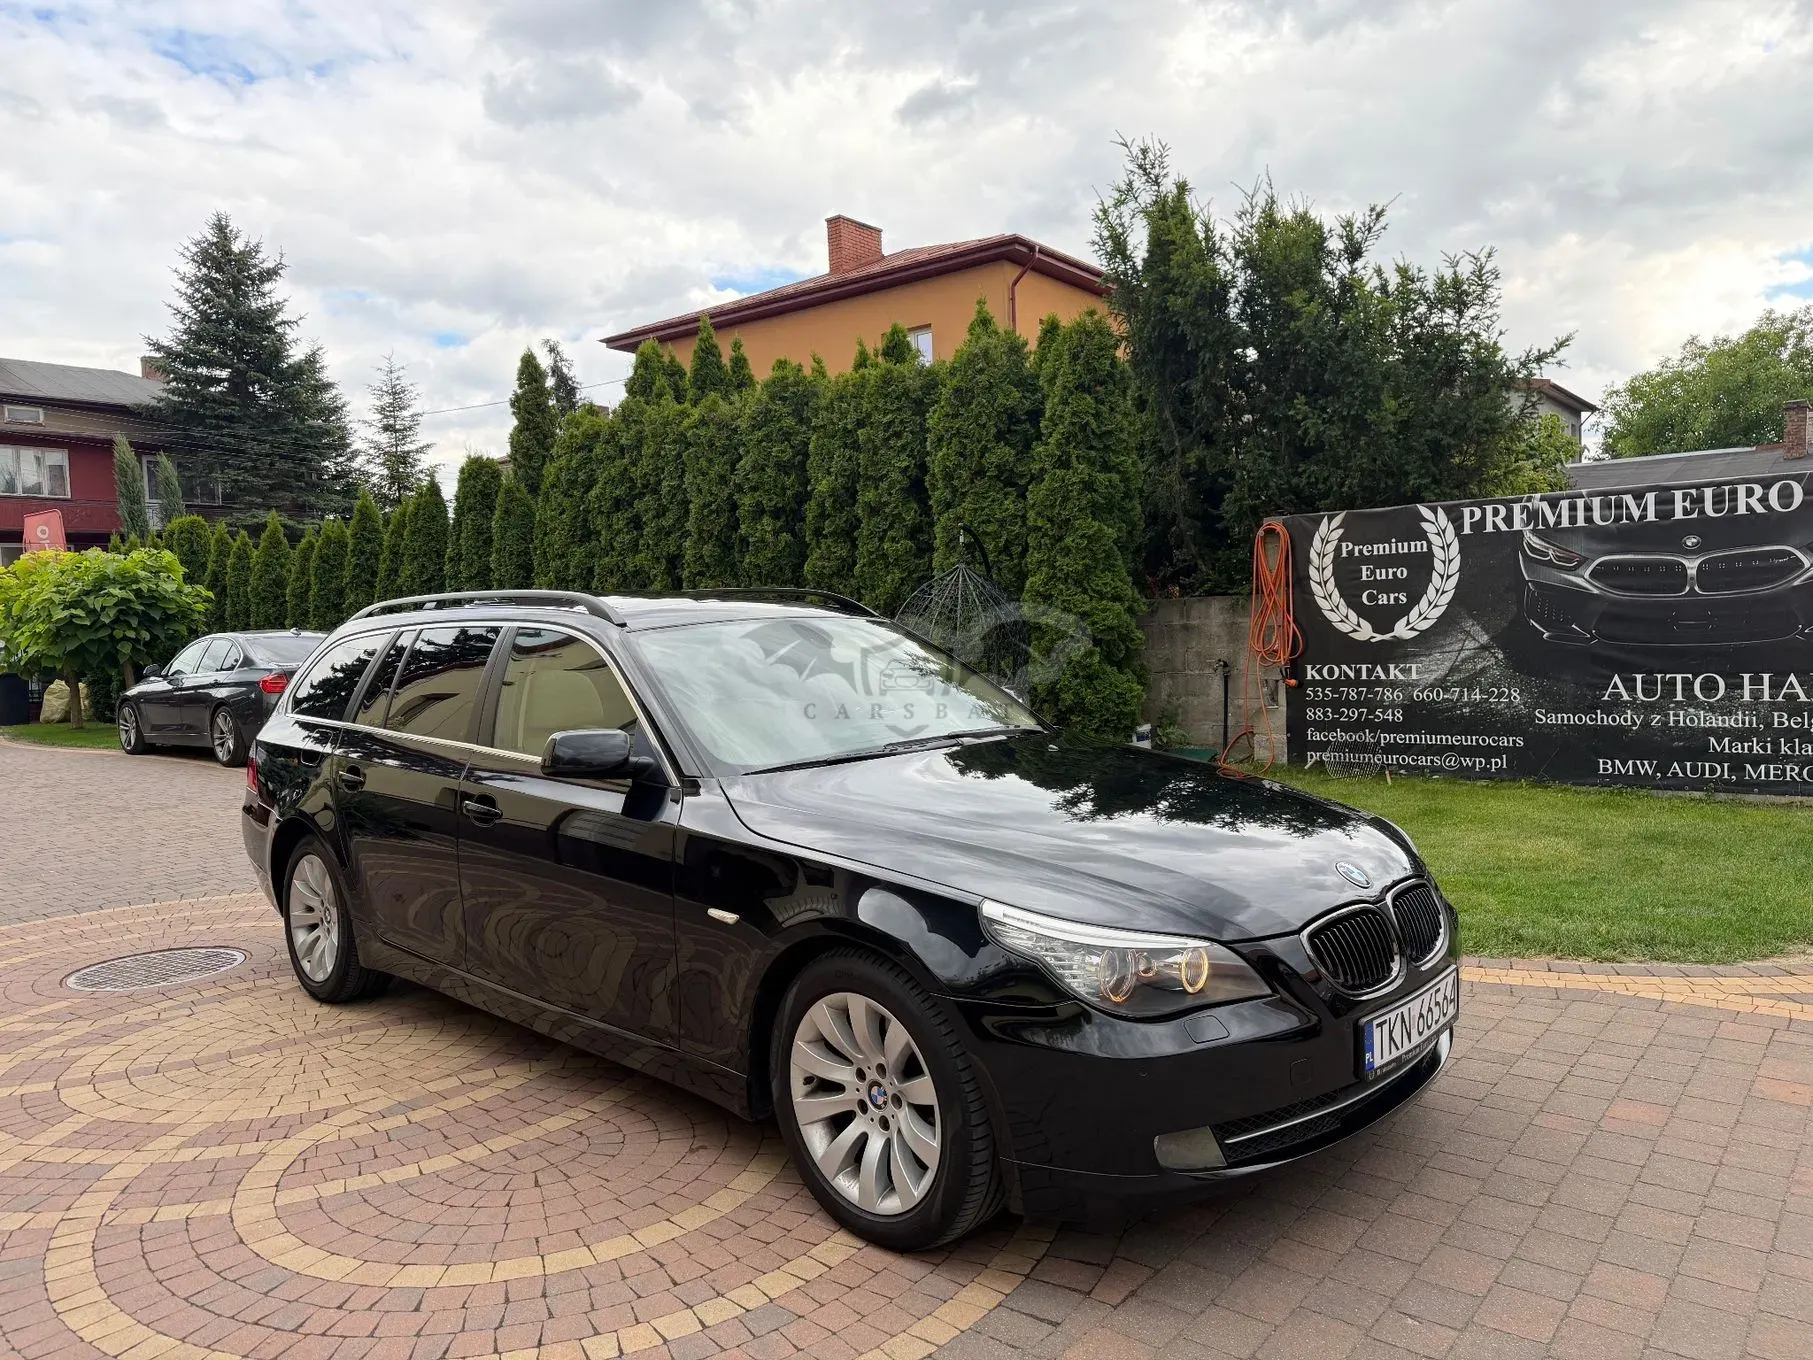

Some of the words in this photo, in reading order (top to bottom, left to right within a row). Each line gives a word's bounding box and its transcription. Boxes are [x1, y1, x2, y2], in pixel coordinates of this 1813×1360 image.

[1461, 492, 1659, 535] PREMIUM
[1671, 480, 1804, 520] EURO
[1340, 538, 1428, 558] Premium
[1360, 565, 1408, 581] Euro
[1361, 589, 1407, 606] Cars
[1304, 664, 1422, 680] KONTAKT
[1305, 687, 1403, 701] 535-787-786
[1413, 687, 1521, 702] 660-714-228
[1600, 673, 1726, 702] AUTO
[1739, 672, 1813, 702] HA
[1305, 708, 1403, 722] 883-297-548
[1534, 708, 1644, 729] Samochody
[1651, 716, 1661, 725] z
[1667, 710, 1764, 731] Holandii,
[1306, 728, 1524, 747] facebook/premiumeurocars
[1708, 736, 1773, 755] Marki
[1306, 750, 1508, 770] premiumeurocars@wp.pl
[1597, 758, 1662, 780] BMW,
[1667, 761, 1737, 782] AUDI,
[1375, 1006, 1412, 1060] TKN
[1417, 975, 1456, 1037] 66564
[1365, 1051, 1374, 1065] PL
